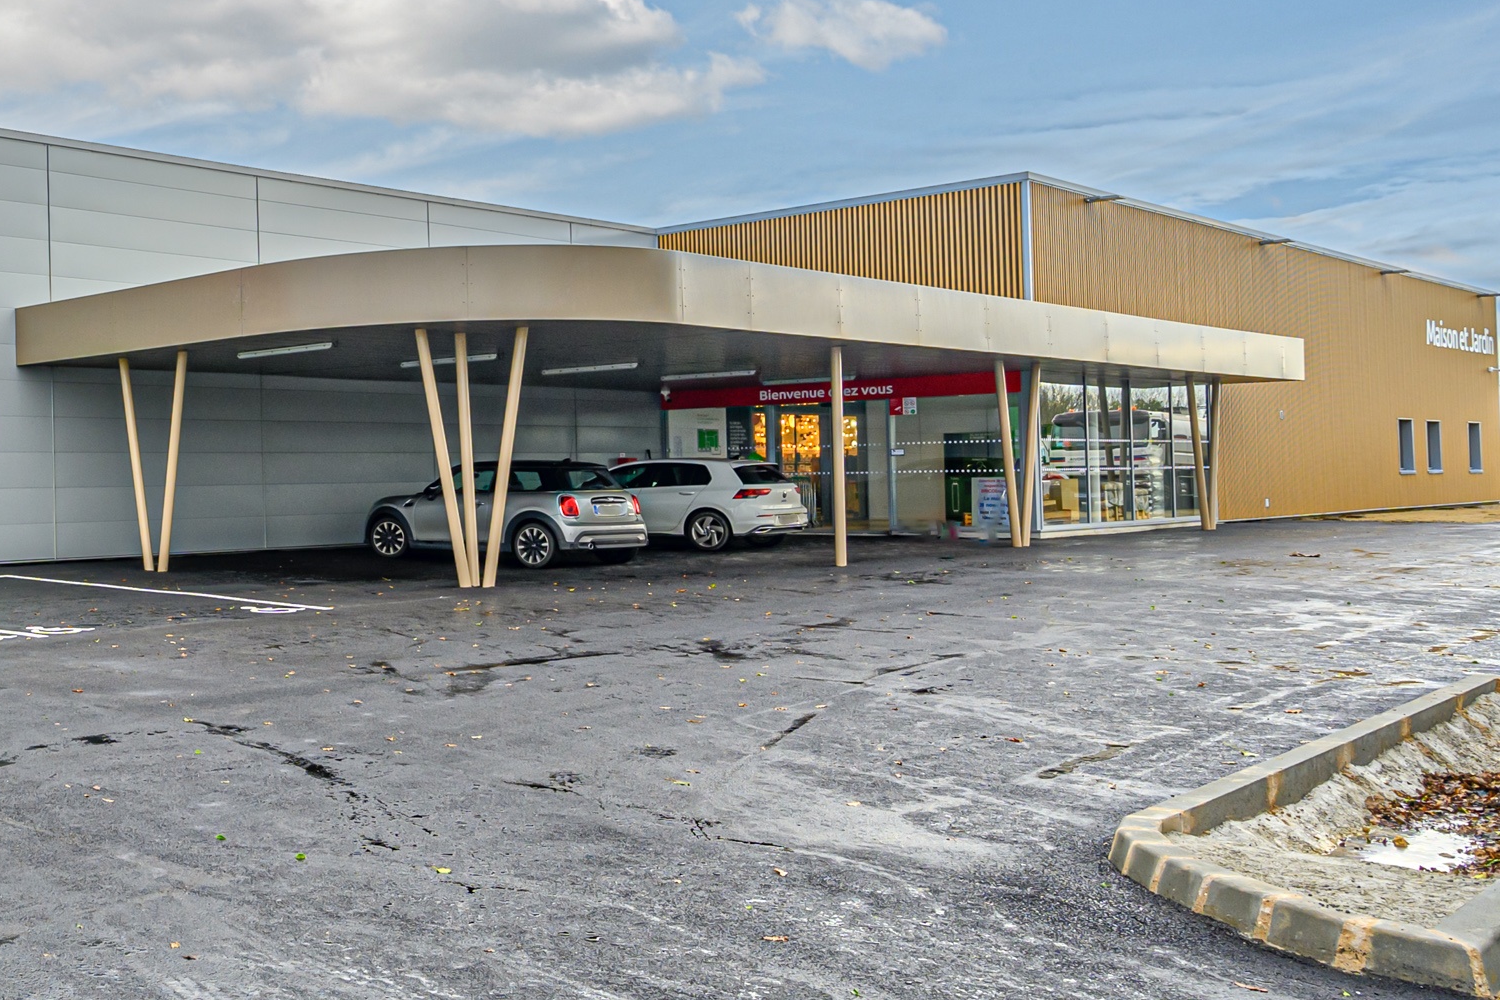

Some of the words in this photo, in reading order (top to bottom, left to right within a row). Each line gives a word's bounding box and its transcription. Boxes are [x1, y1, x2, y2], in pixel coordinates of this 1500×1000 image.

[1426, 319, 1459, 349] Maison
[1459, 327, 1469, 351] et
[1469, 327, 1494, 355] Jardin
[759, 389, 825, 401] Bienvenue
[828, 387, 859, 397] cez
[861, 385, 894, 395] vous
